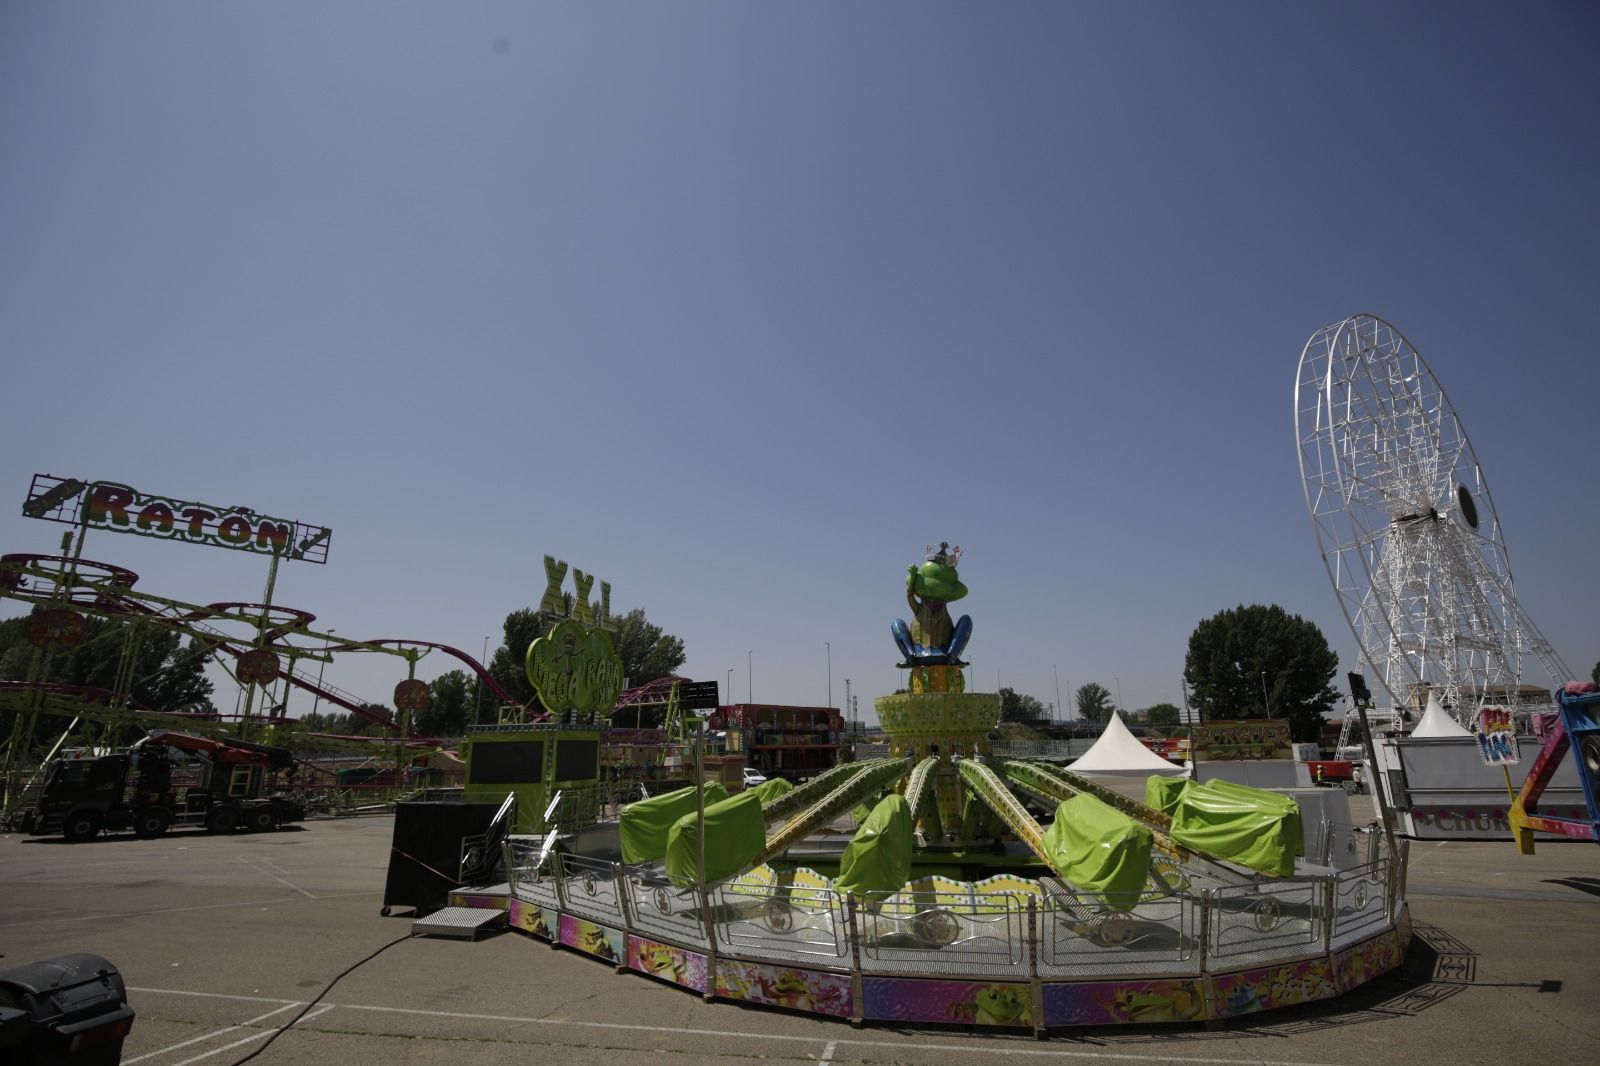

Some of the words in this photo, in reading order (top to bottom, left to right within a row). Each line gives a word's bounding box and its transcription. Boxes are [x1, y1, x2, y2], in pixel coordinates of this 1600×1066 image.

[87, 485, 289, 550] RATÓN
[540, 554, 619, 632] XXL
[1196, 725, 1292, 747] BURGUER
[1434, 812, 1511, 832] CHUR
